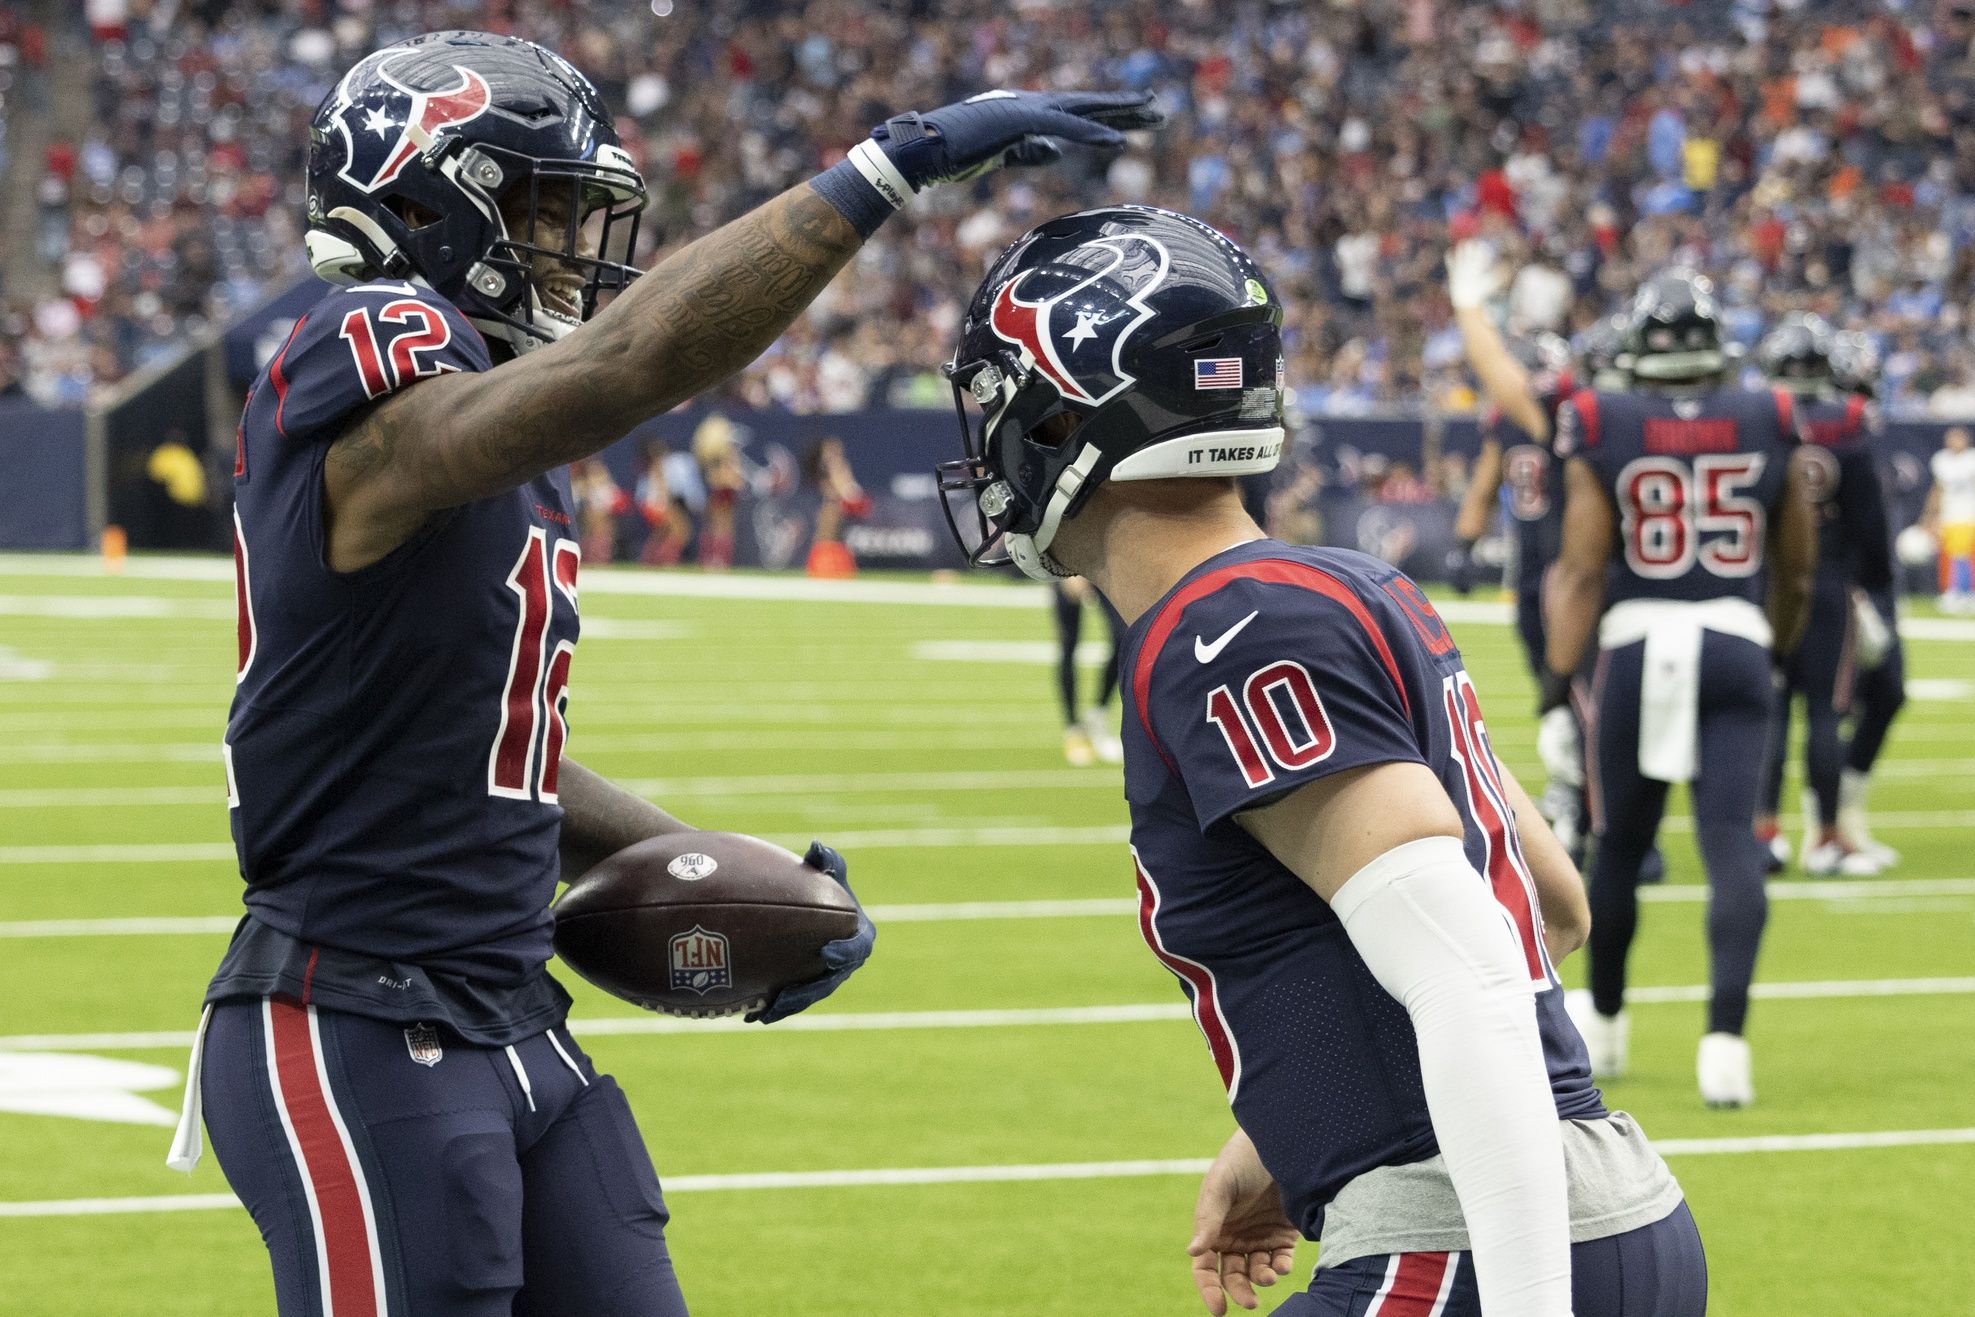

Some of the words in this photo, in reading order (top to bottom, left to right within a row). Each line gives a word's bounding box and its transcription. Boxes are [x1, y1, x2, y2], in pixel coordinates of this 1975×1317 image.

[338, 299, 462, 401] 12
[1188, 449, 1204, 464] IT
[1208, 447, 1255, 463] TAKES
[1256, 446, 1273, 460] ALL
[1617, 452, 1768, 580] 85
[1206, 660, 1336, 789] 10
[675, 936, 723, 968] NFL
